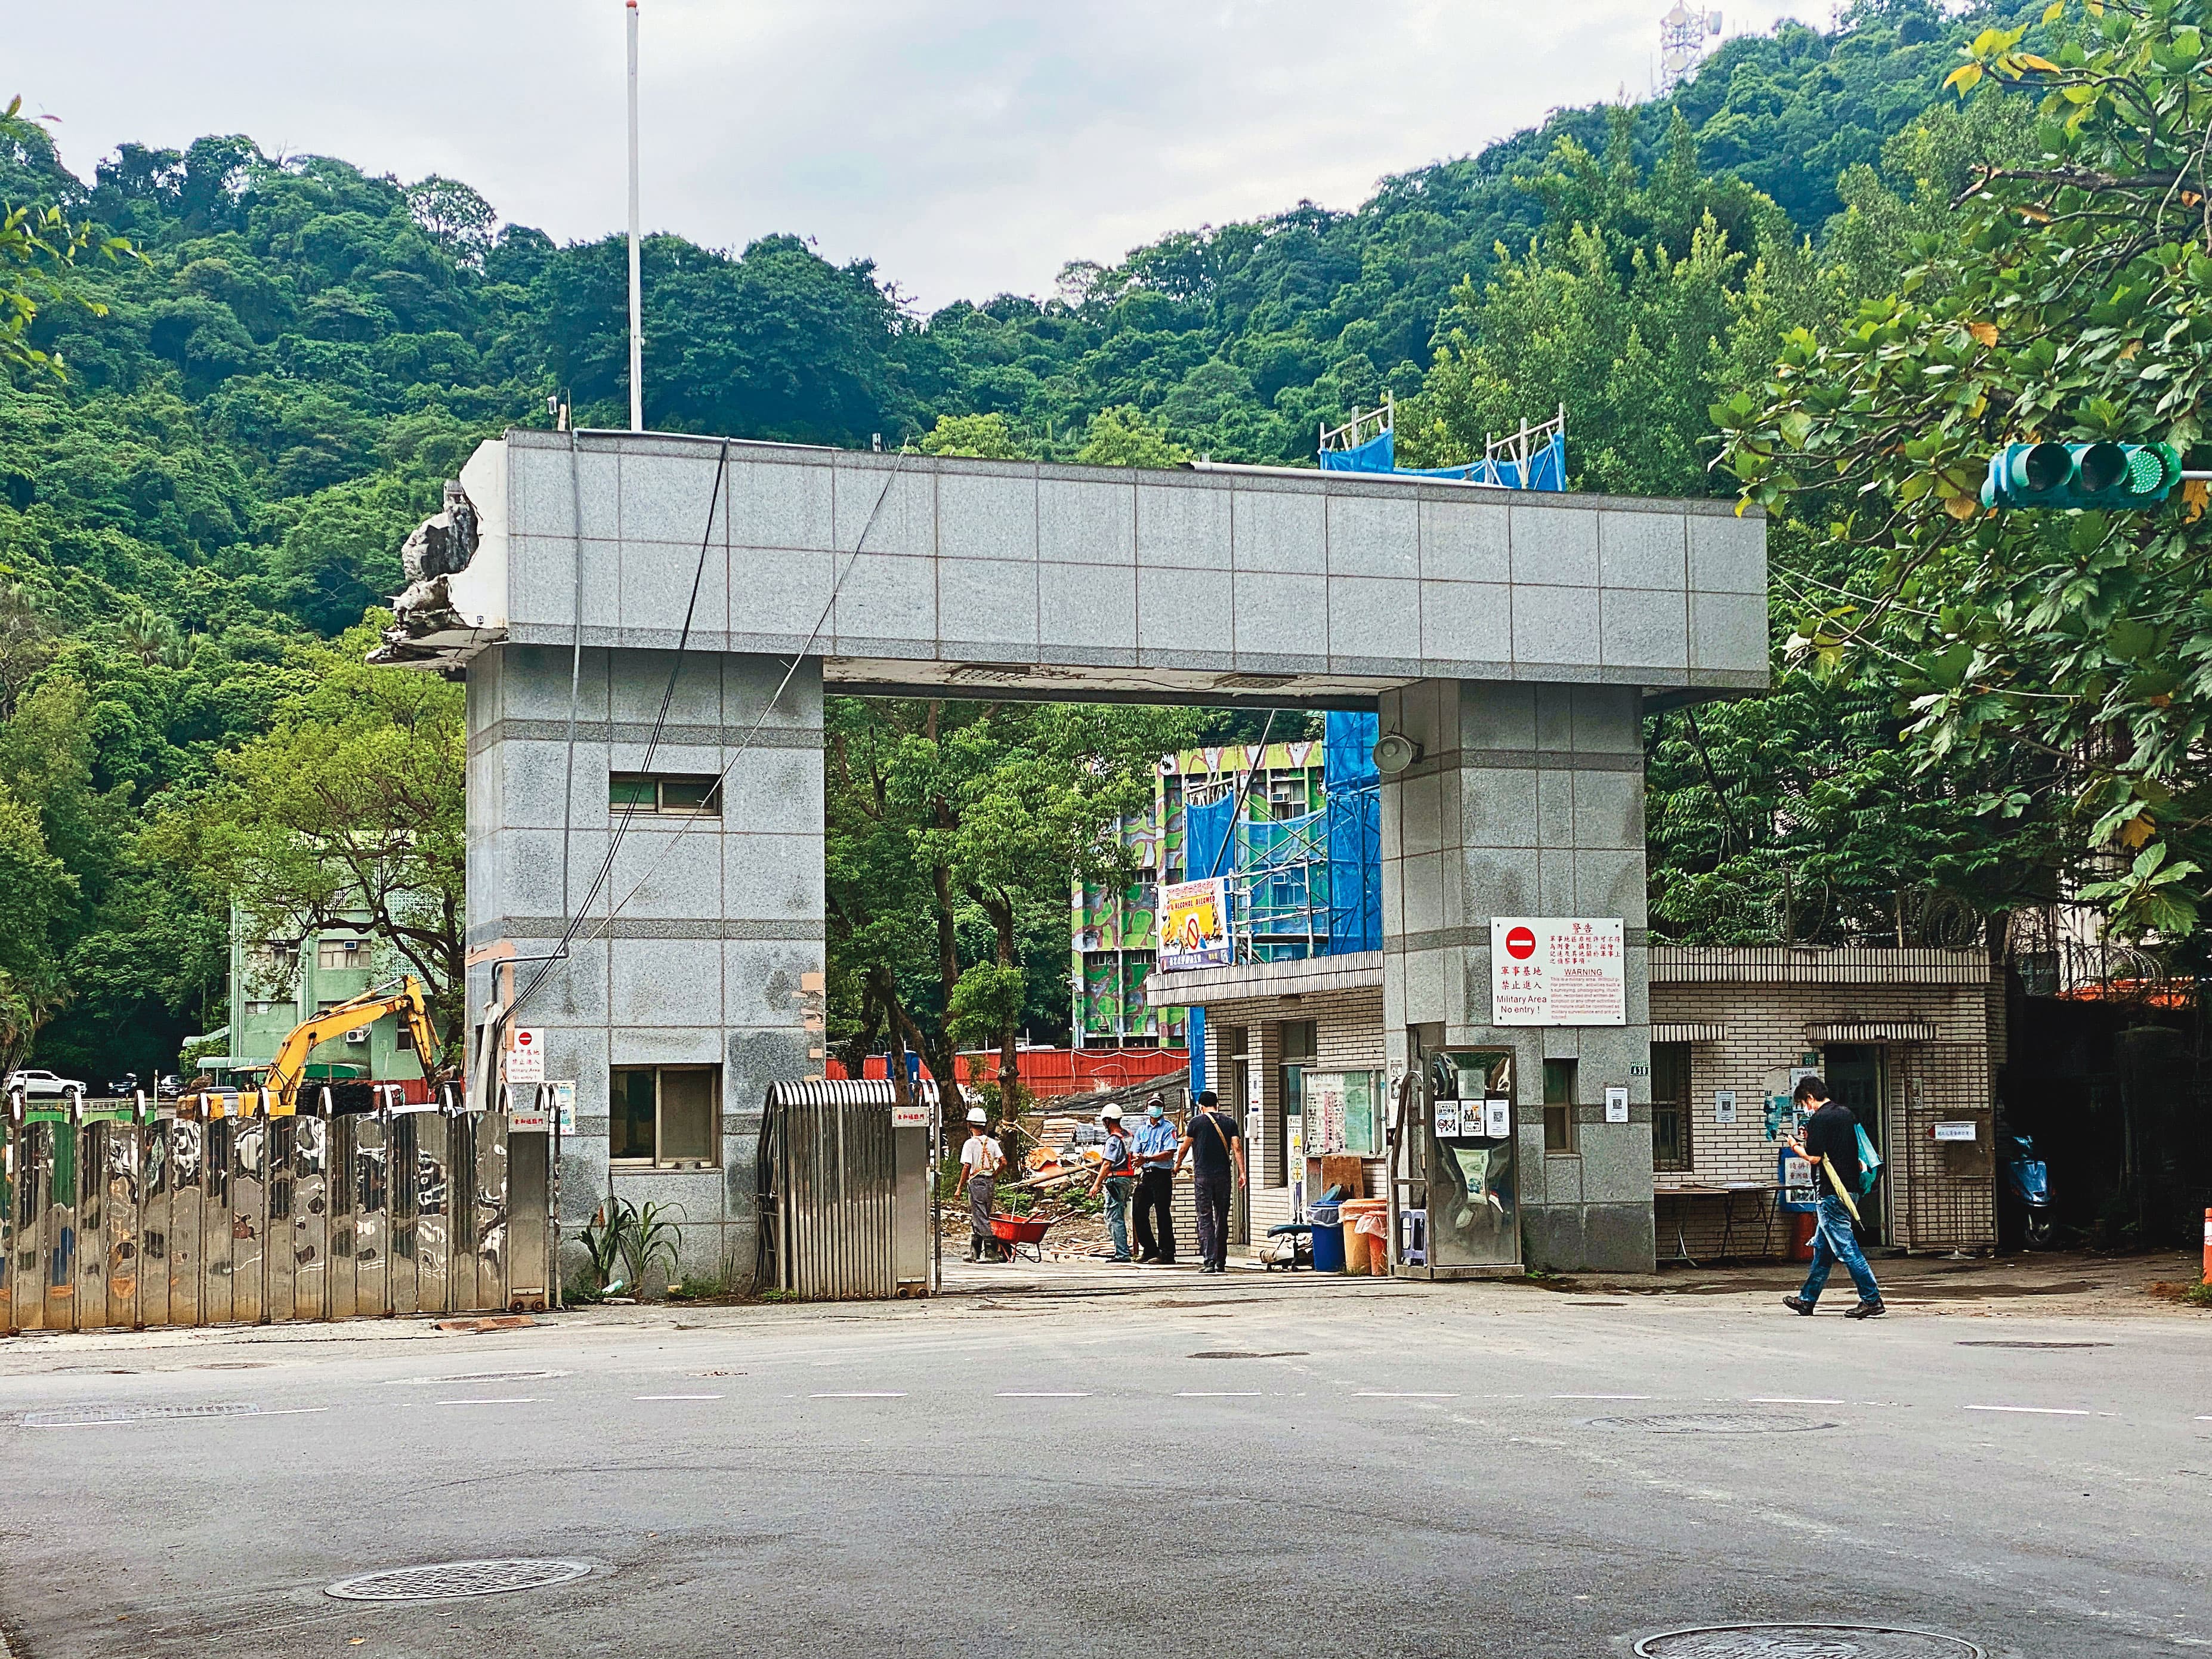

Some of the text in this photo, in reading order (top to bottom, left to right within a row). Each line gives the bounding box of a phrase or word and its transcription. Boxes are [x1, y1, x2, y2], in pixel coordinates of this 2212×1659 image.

[1175, 900, 1193, 910] ALCOHOL
[1195, 895, 1216, 906] ALLOWED
[1573, 923, 1593, 933] 警告
[1501, 966, 1542, 977] 軍事基地
[1502, 981, 1542, 990] 禁止進入
[1497, 995, 1527, 1005] Military
[1514, 1006, 1535, 1015] entry
